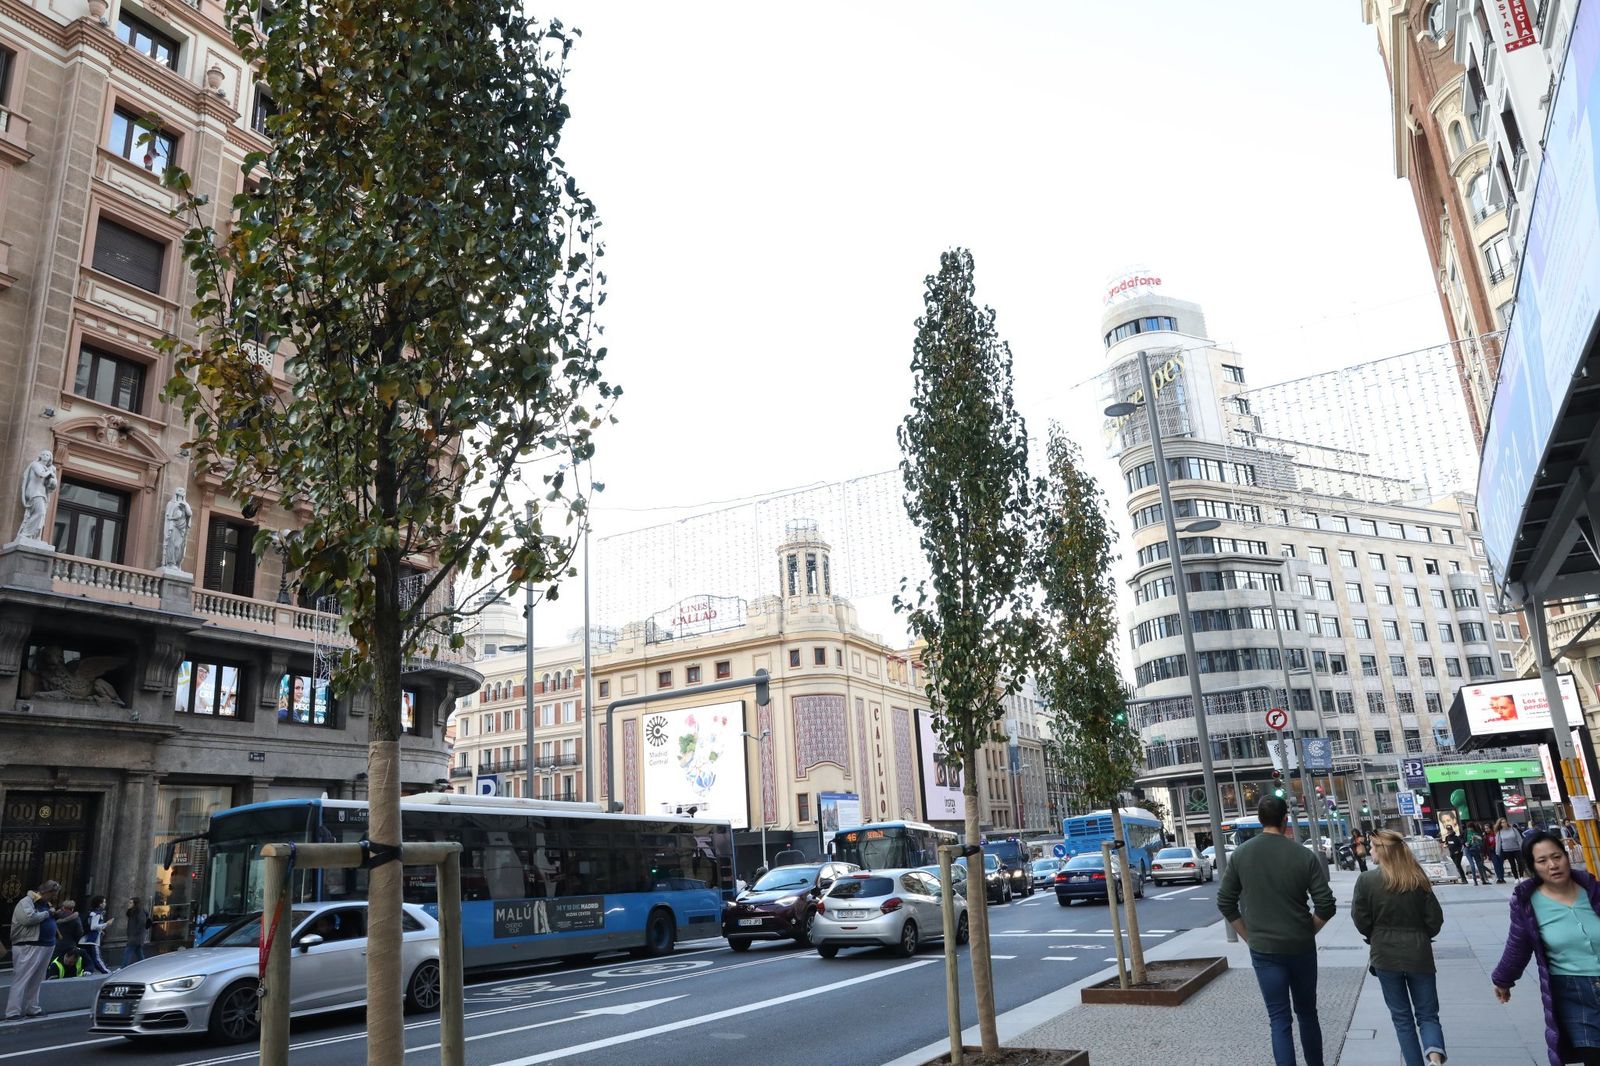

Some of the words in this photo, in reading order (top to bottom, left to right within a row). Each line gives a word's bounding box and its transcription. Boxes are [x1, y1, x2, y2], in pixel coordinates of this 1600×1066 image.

[1496, 0, 1513, 37] STAL
[1108, 276, 1162, 297] vodafone
[671, 610, 717, 626] CALLAO
[873, 708, 886, 814] CALLAO
[847, 832, 857, 842] 46
[496, 905, 532, 922] MALÚ
